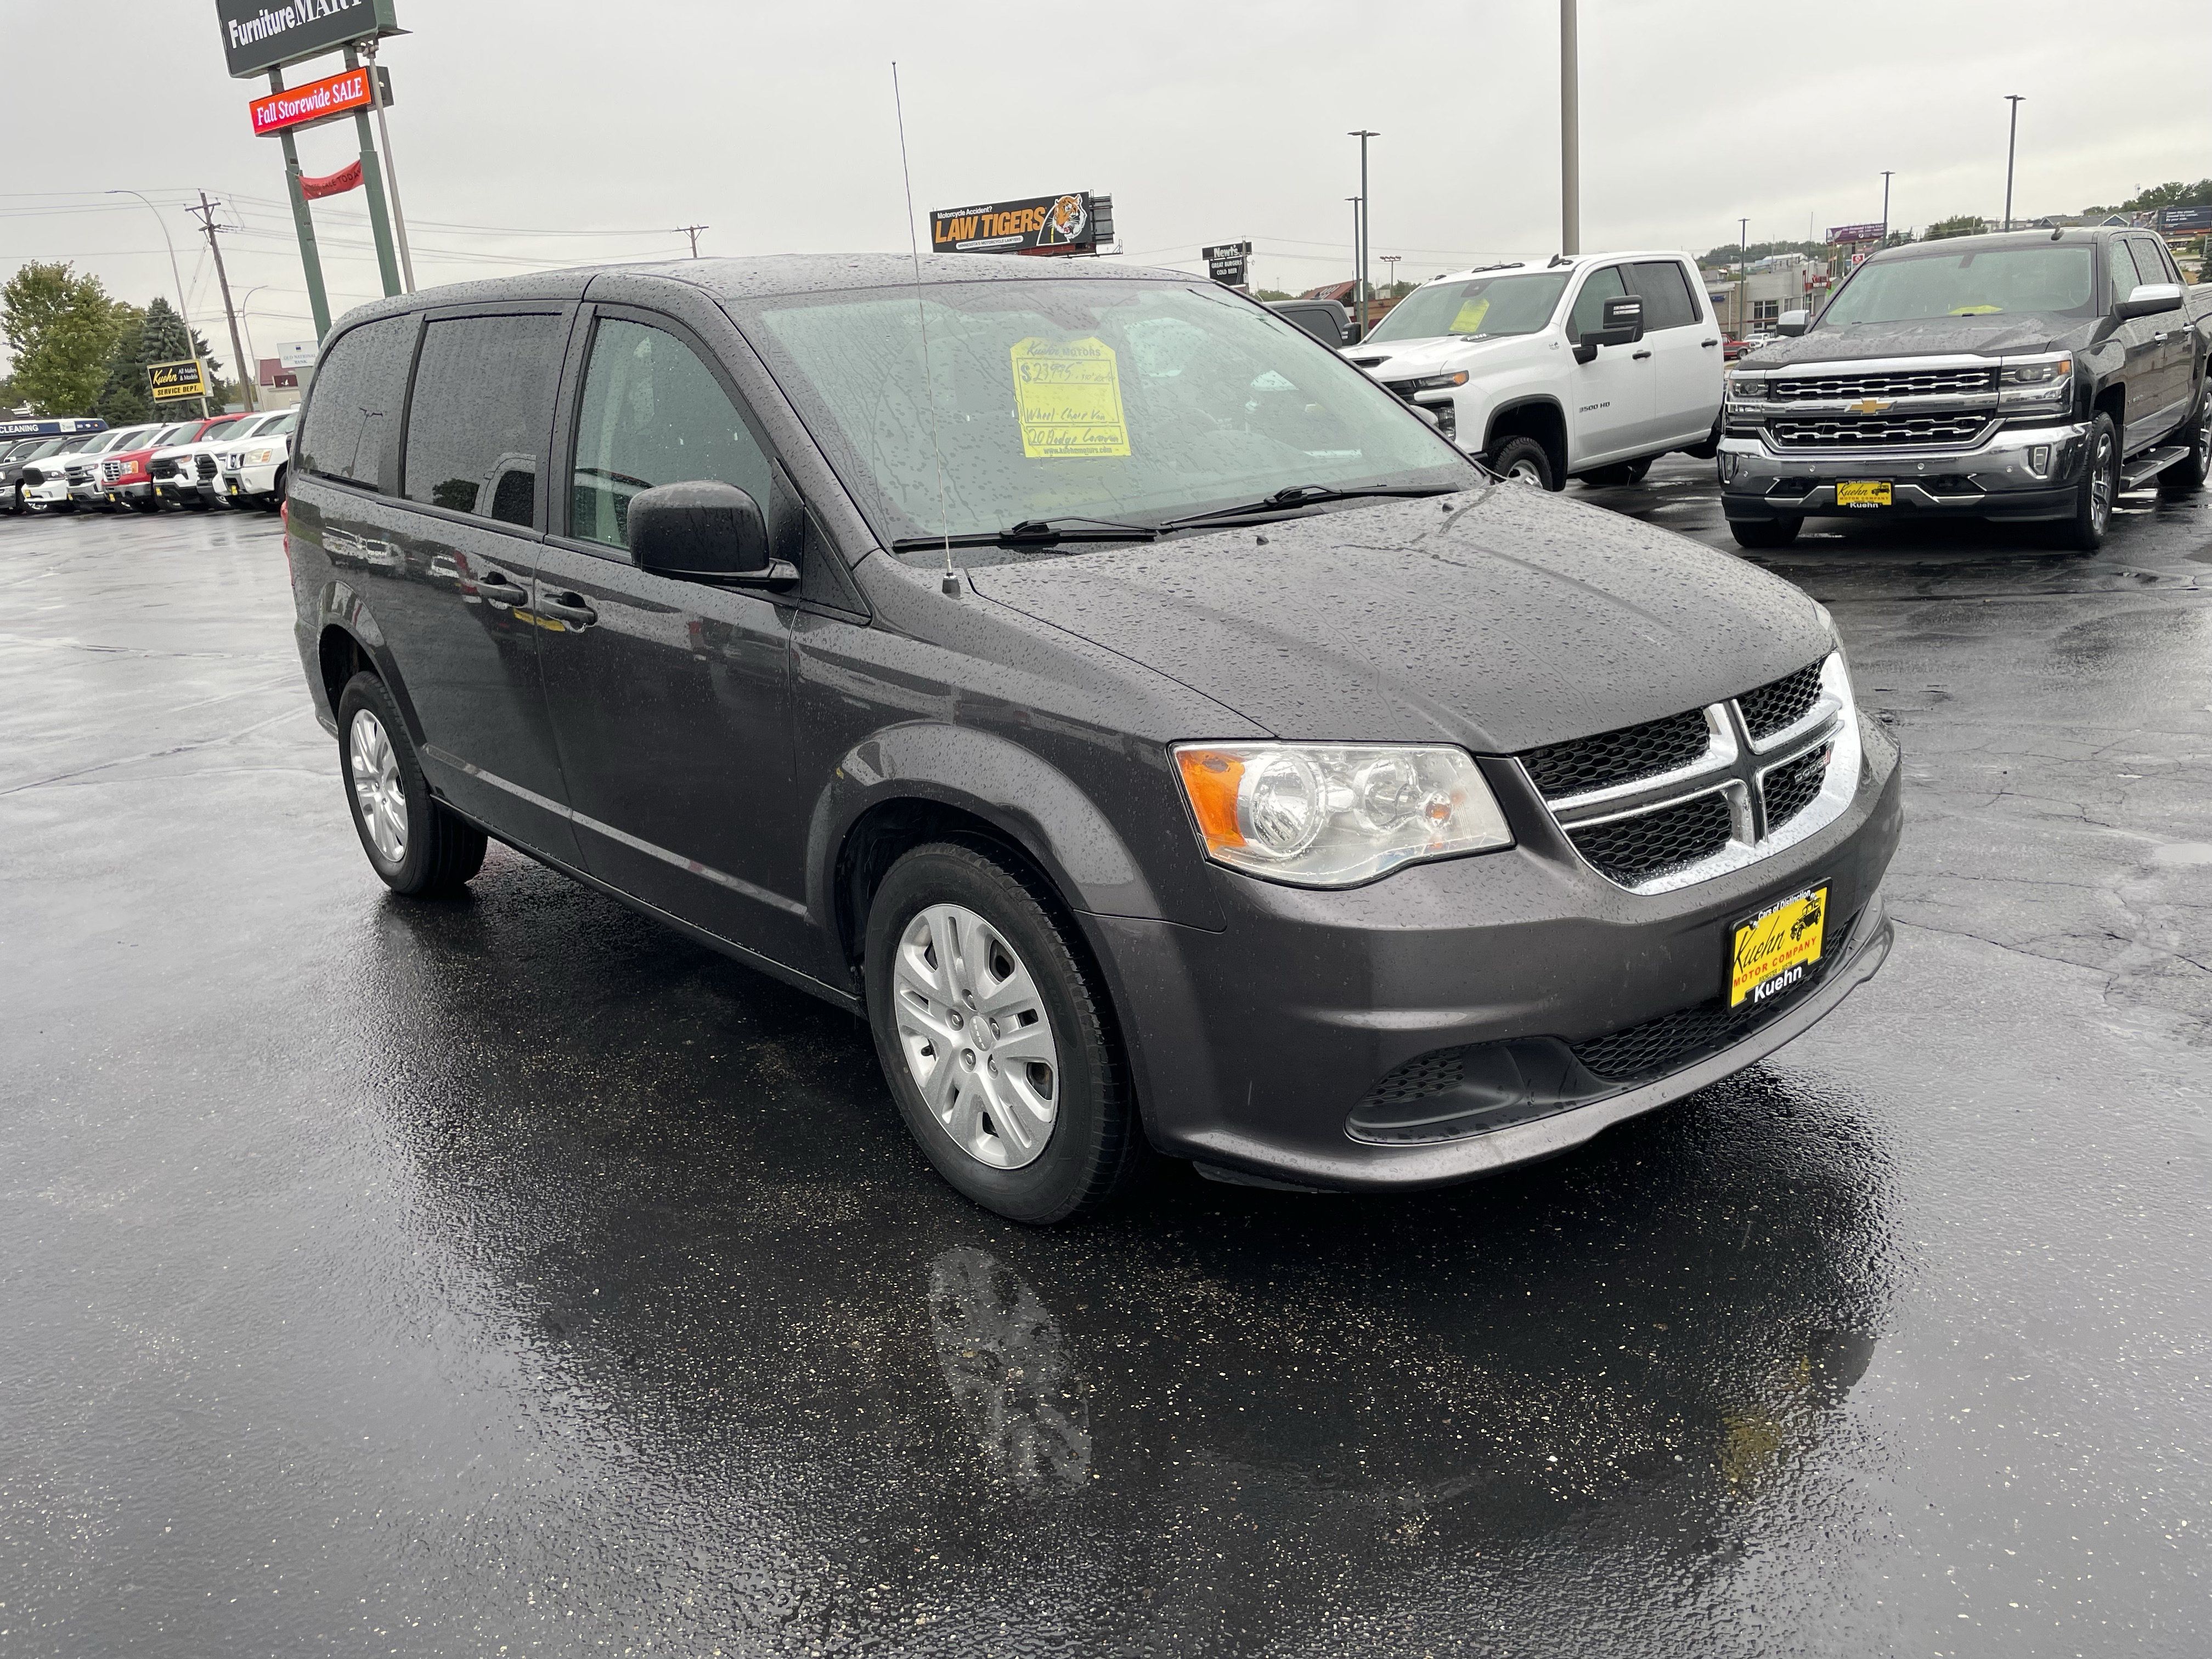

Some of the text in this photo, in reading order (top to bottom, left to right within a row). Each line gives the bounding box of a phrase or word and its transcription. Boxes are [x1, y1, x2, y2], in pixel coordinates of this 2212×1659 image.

[228, 0, 362, 49] FurnitureMA
[257, 77, 363, 126] Fall Storewide SALE
[937, 206, 993, 219] Motorcycle Accident?
[935, 206, 1046, 244] LAW TIGERS
[1214, 244, 1238, 258] Newt's
[1027, 341, 1101, 357] Kuehn MOTORS
[153, 368, 178, 385] Kuehn
[157, 385, 199, 396] SERVICE DEPT.
[1026, 408, 1055, 422] Wheel
[1091, 409, 1106, 421] Van
[0, 424, 39, 434] CLEANING
[1046, 428, 1077, 449] Dodge
[1838, 483, 1868, 496] Kuehn
[1758, 889, 1810, 920] Cars of Distinction
[1734, 915, 1785, 974] Kuehn
[1734, 936, 1817, 988] MOTOR COMPANY
[1754, 966, 1802, 1003] Kuehn
